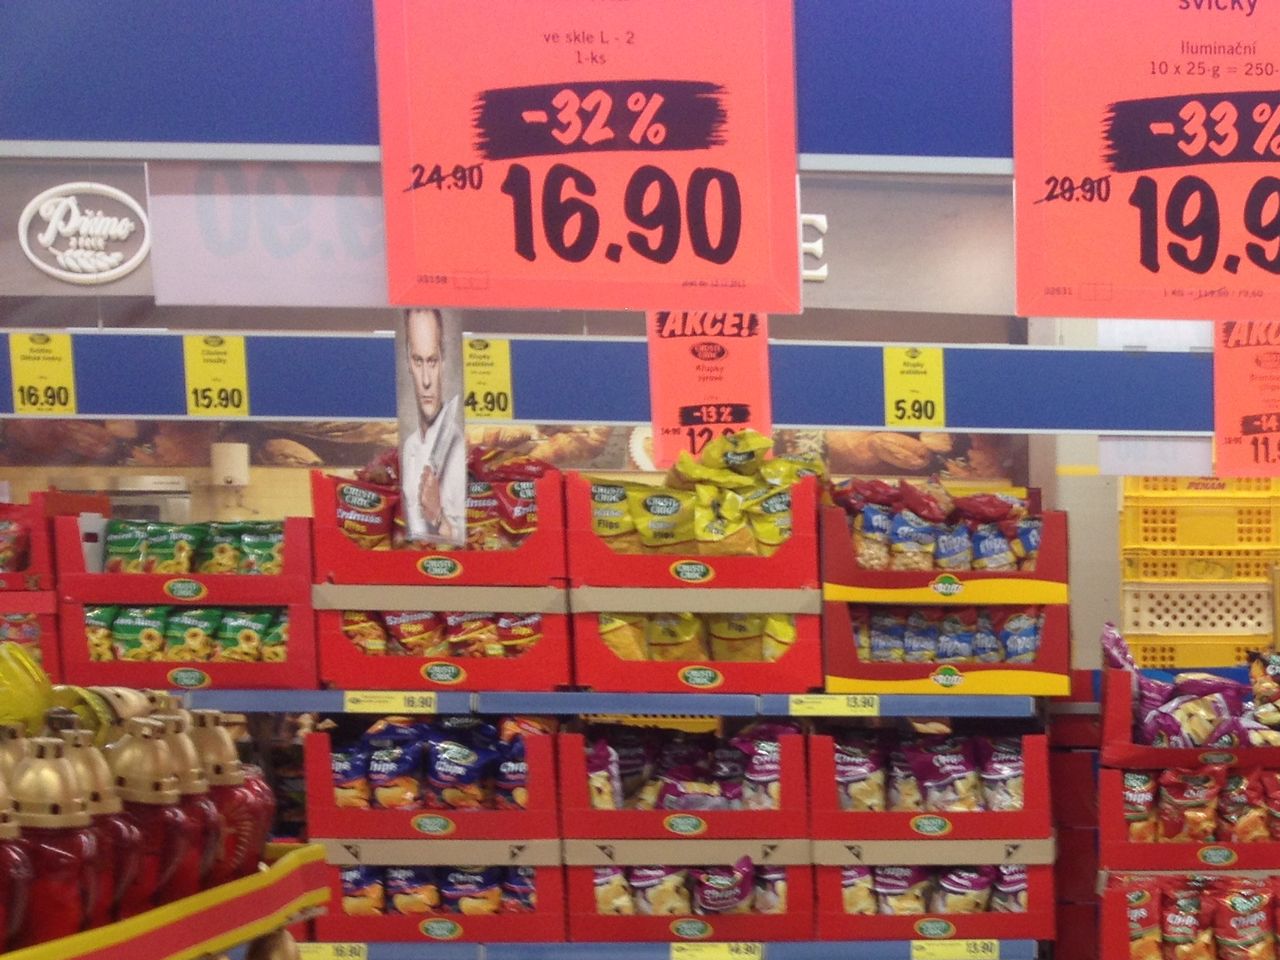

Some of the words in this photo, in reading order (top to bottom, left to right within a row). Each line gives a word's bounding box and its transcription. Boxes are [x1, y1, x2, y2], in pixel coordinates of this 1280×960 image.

[543, 33, 560, 44] ve
[566, 30, 595, 44] skle
[600, 31, 609, 44] L
[626, 31, 635, 44] 2
[1150, 62, 1168, 75] 10
[1173, 65, 1182, 75] x
[501, 163, 741, 265] 16.90
[661, 312, 752, 338] AKCE!
[17, 386, 69, 406] 16.90
[192, 388, 242, 408] 15.90
[894, 399, 935, 420] 5.90
